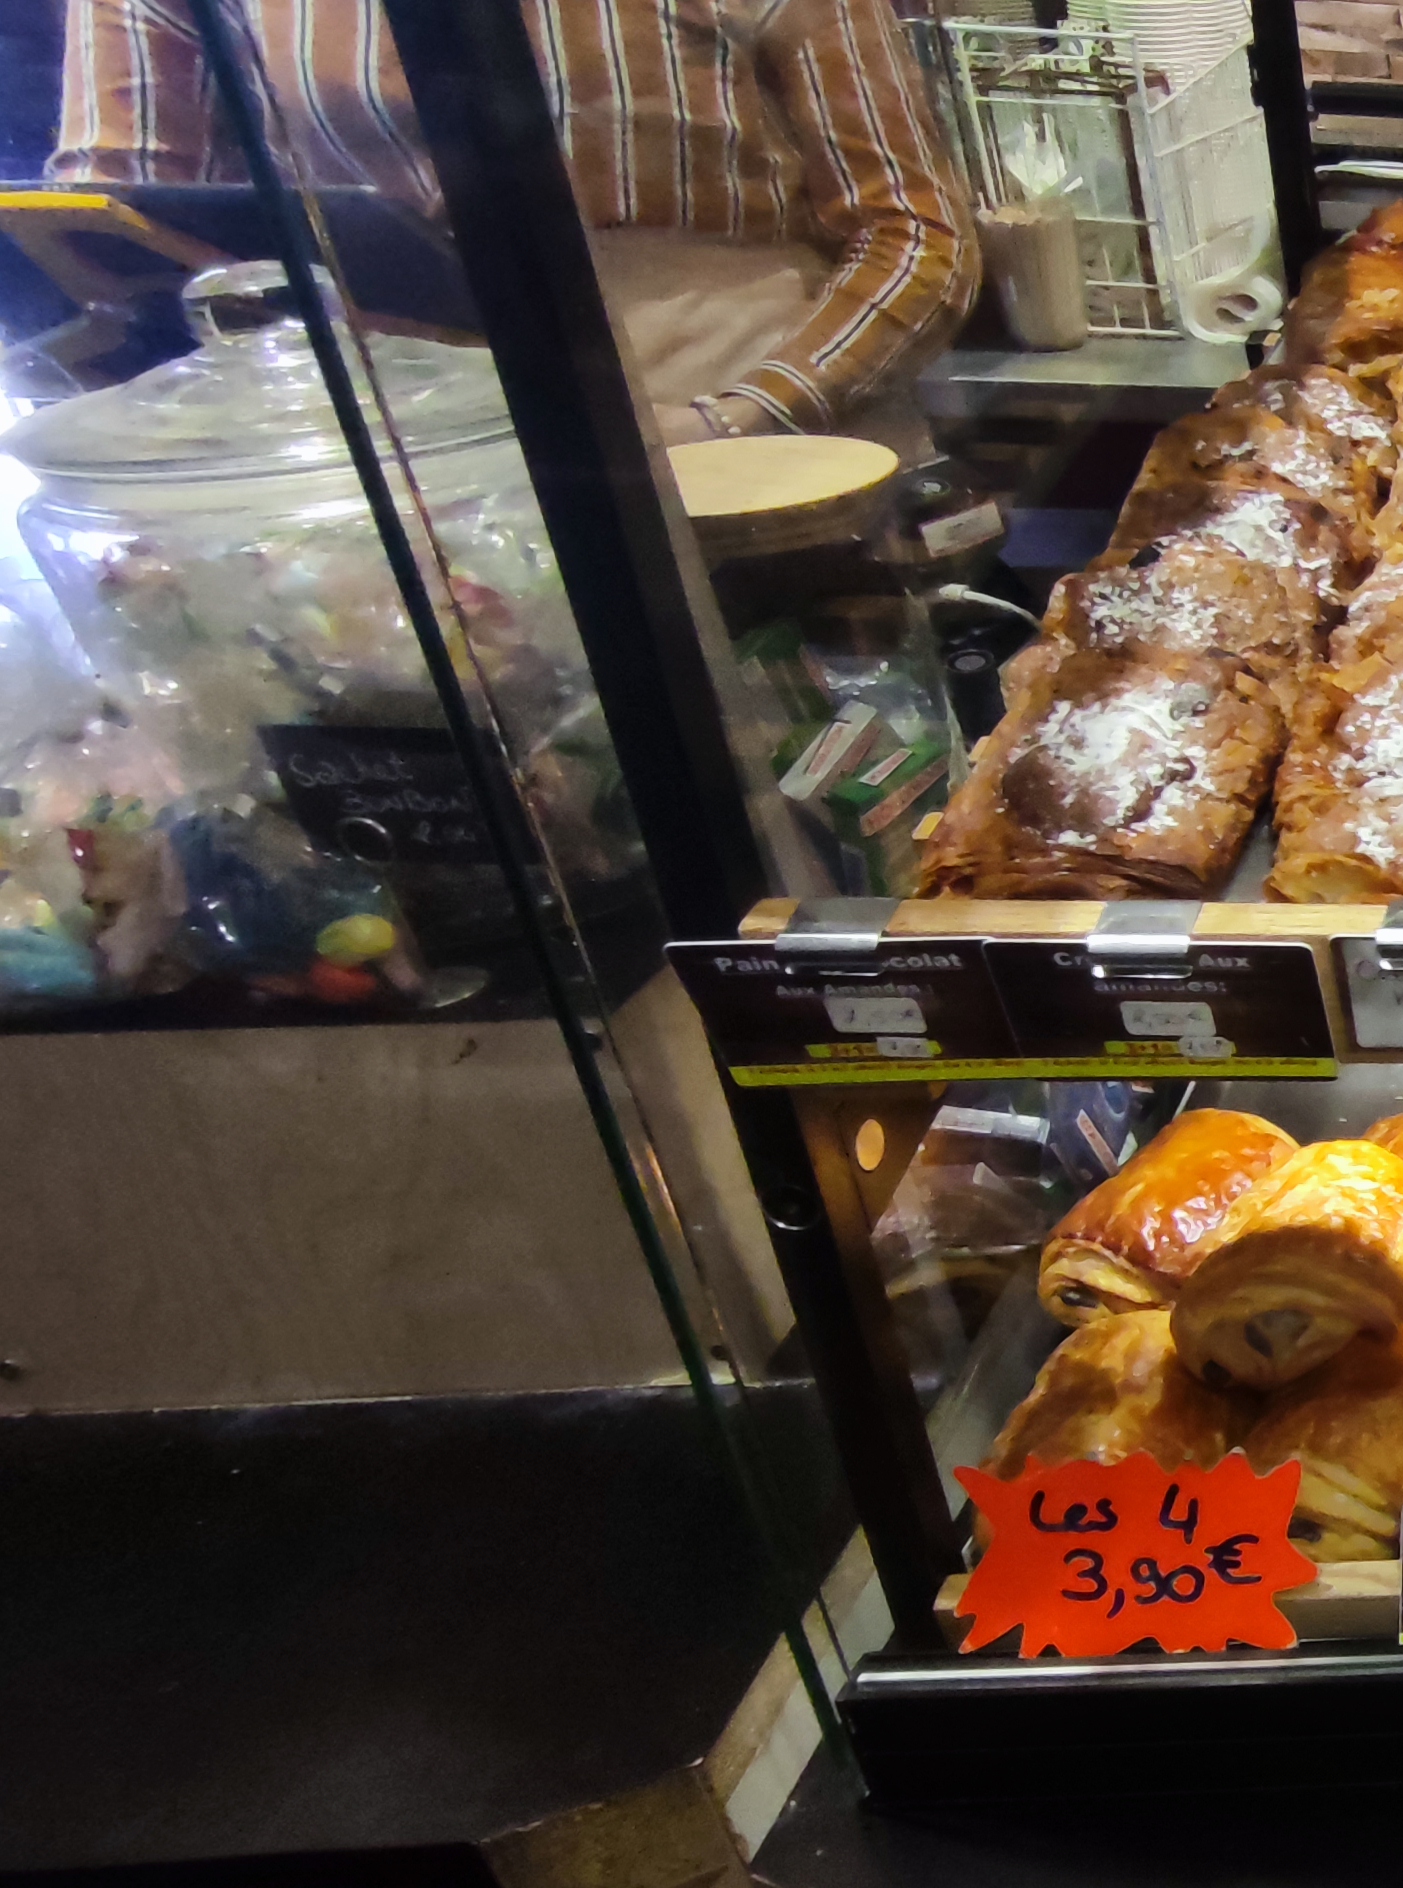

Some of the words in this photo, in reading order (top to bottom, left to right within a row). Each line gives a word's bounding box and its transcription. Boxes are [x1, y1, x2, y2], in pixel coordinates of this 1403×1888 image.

[714, 957, 780, 974] Pain
[1029, 1490, 1119, 1533] Les
[1159, 1483, 1199, 1545] 4
[1060, 1533, 1263, 1620] 3,90€
